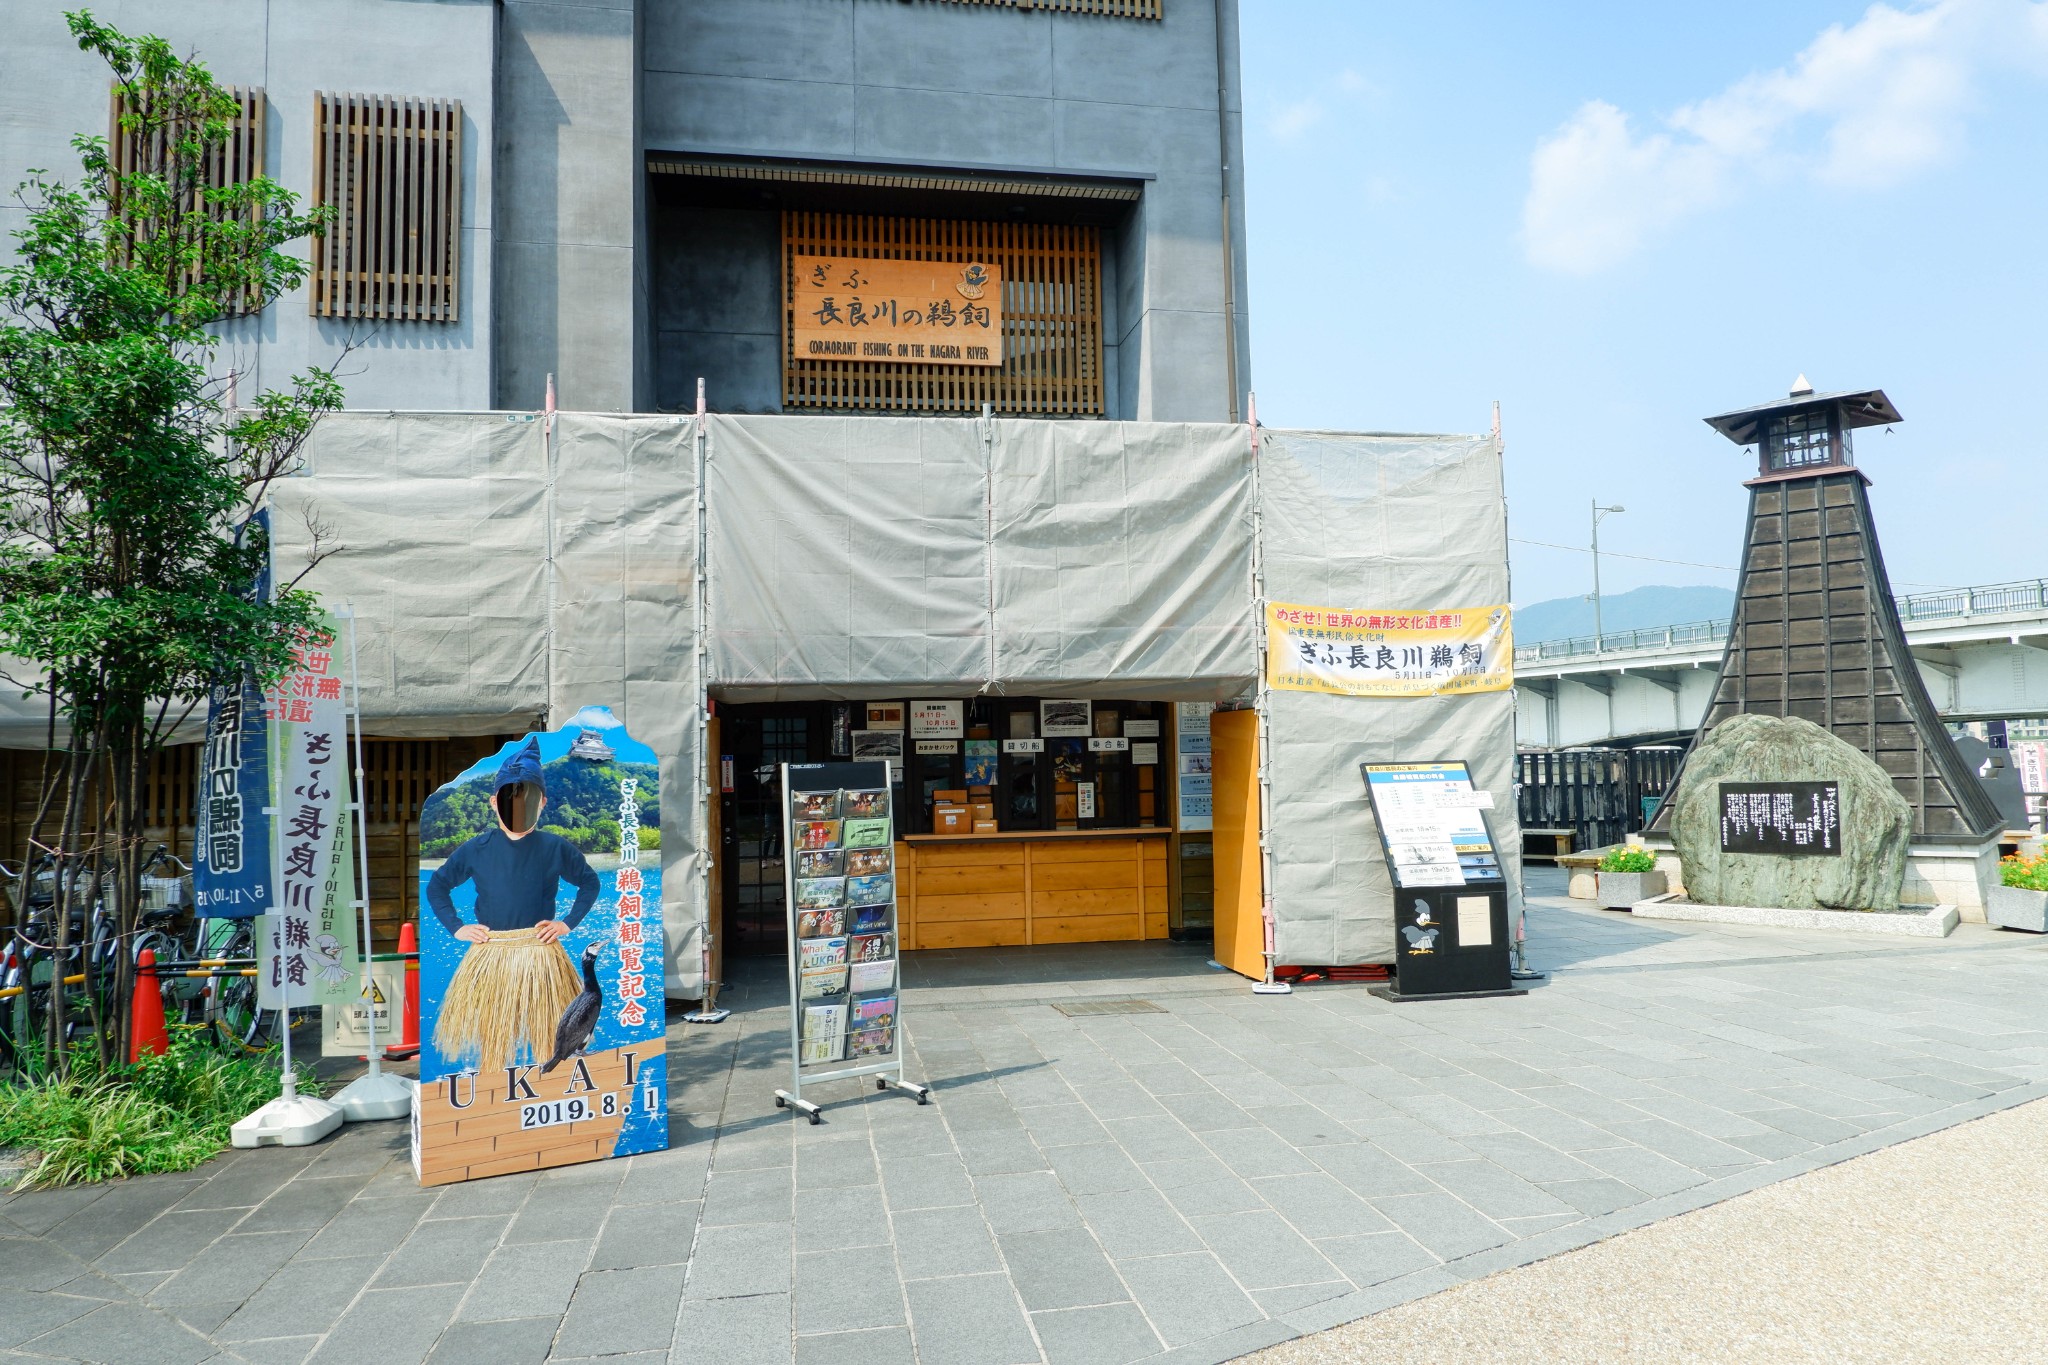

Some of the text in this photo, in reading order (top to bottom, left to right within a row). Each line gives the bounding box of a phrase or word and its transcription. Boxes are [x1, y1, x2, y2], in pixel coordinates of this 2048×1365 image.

[811, 264, 868, 289] ぎふ
[812, 296, 990, 329] 長良川の鵜飼
[809, 340, 989, 361] CORMORANT FISHING ON THE NAGARA RIVER
[1288, 626, 1385, 643] 国重要無形民俗文化財
[1300, 640, 1483, 671] ぎふ長良川鵜飼
[621, 779, 638, 863] ぎふ長良川
[617, 868, 645, 1026] 鵜飼観覧記念
[446, 1053, 637, 1109] UKAI
